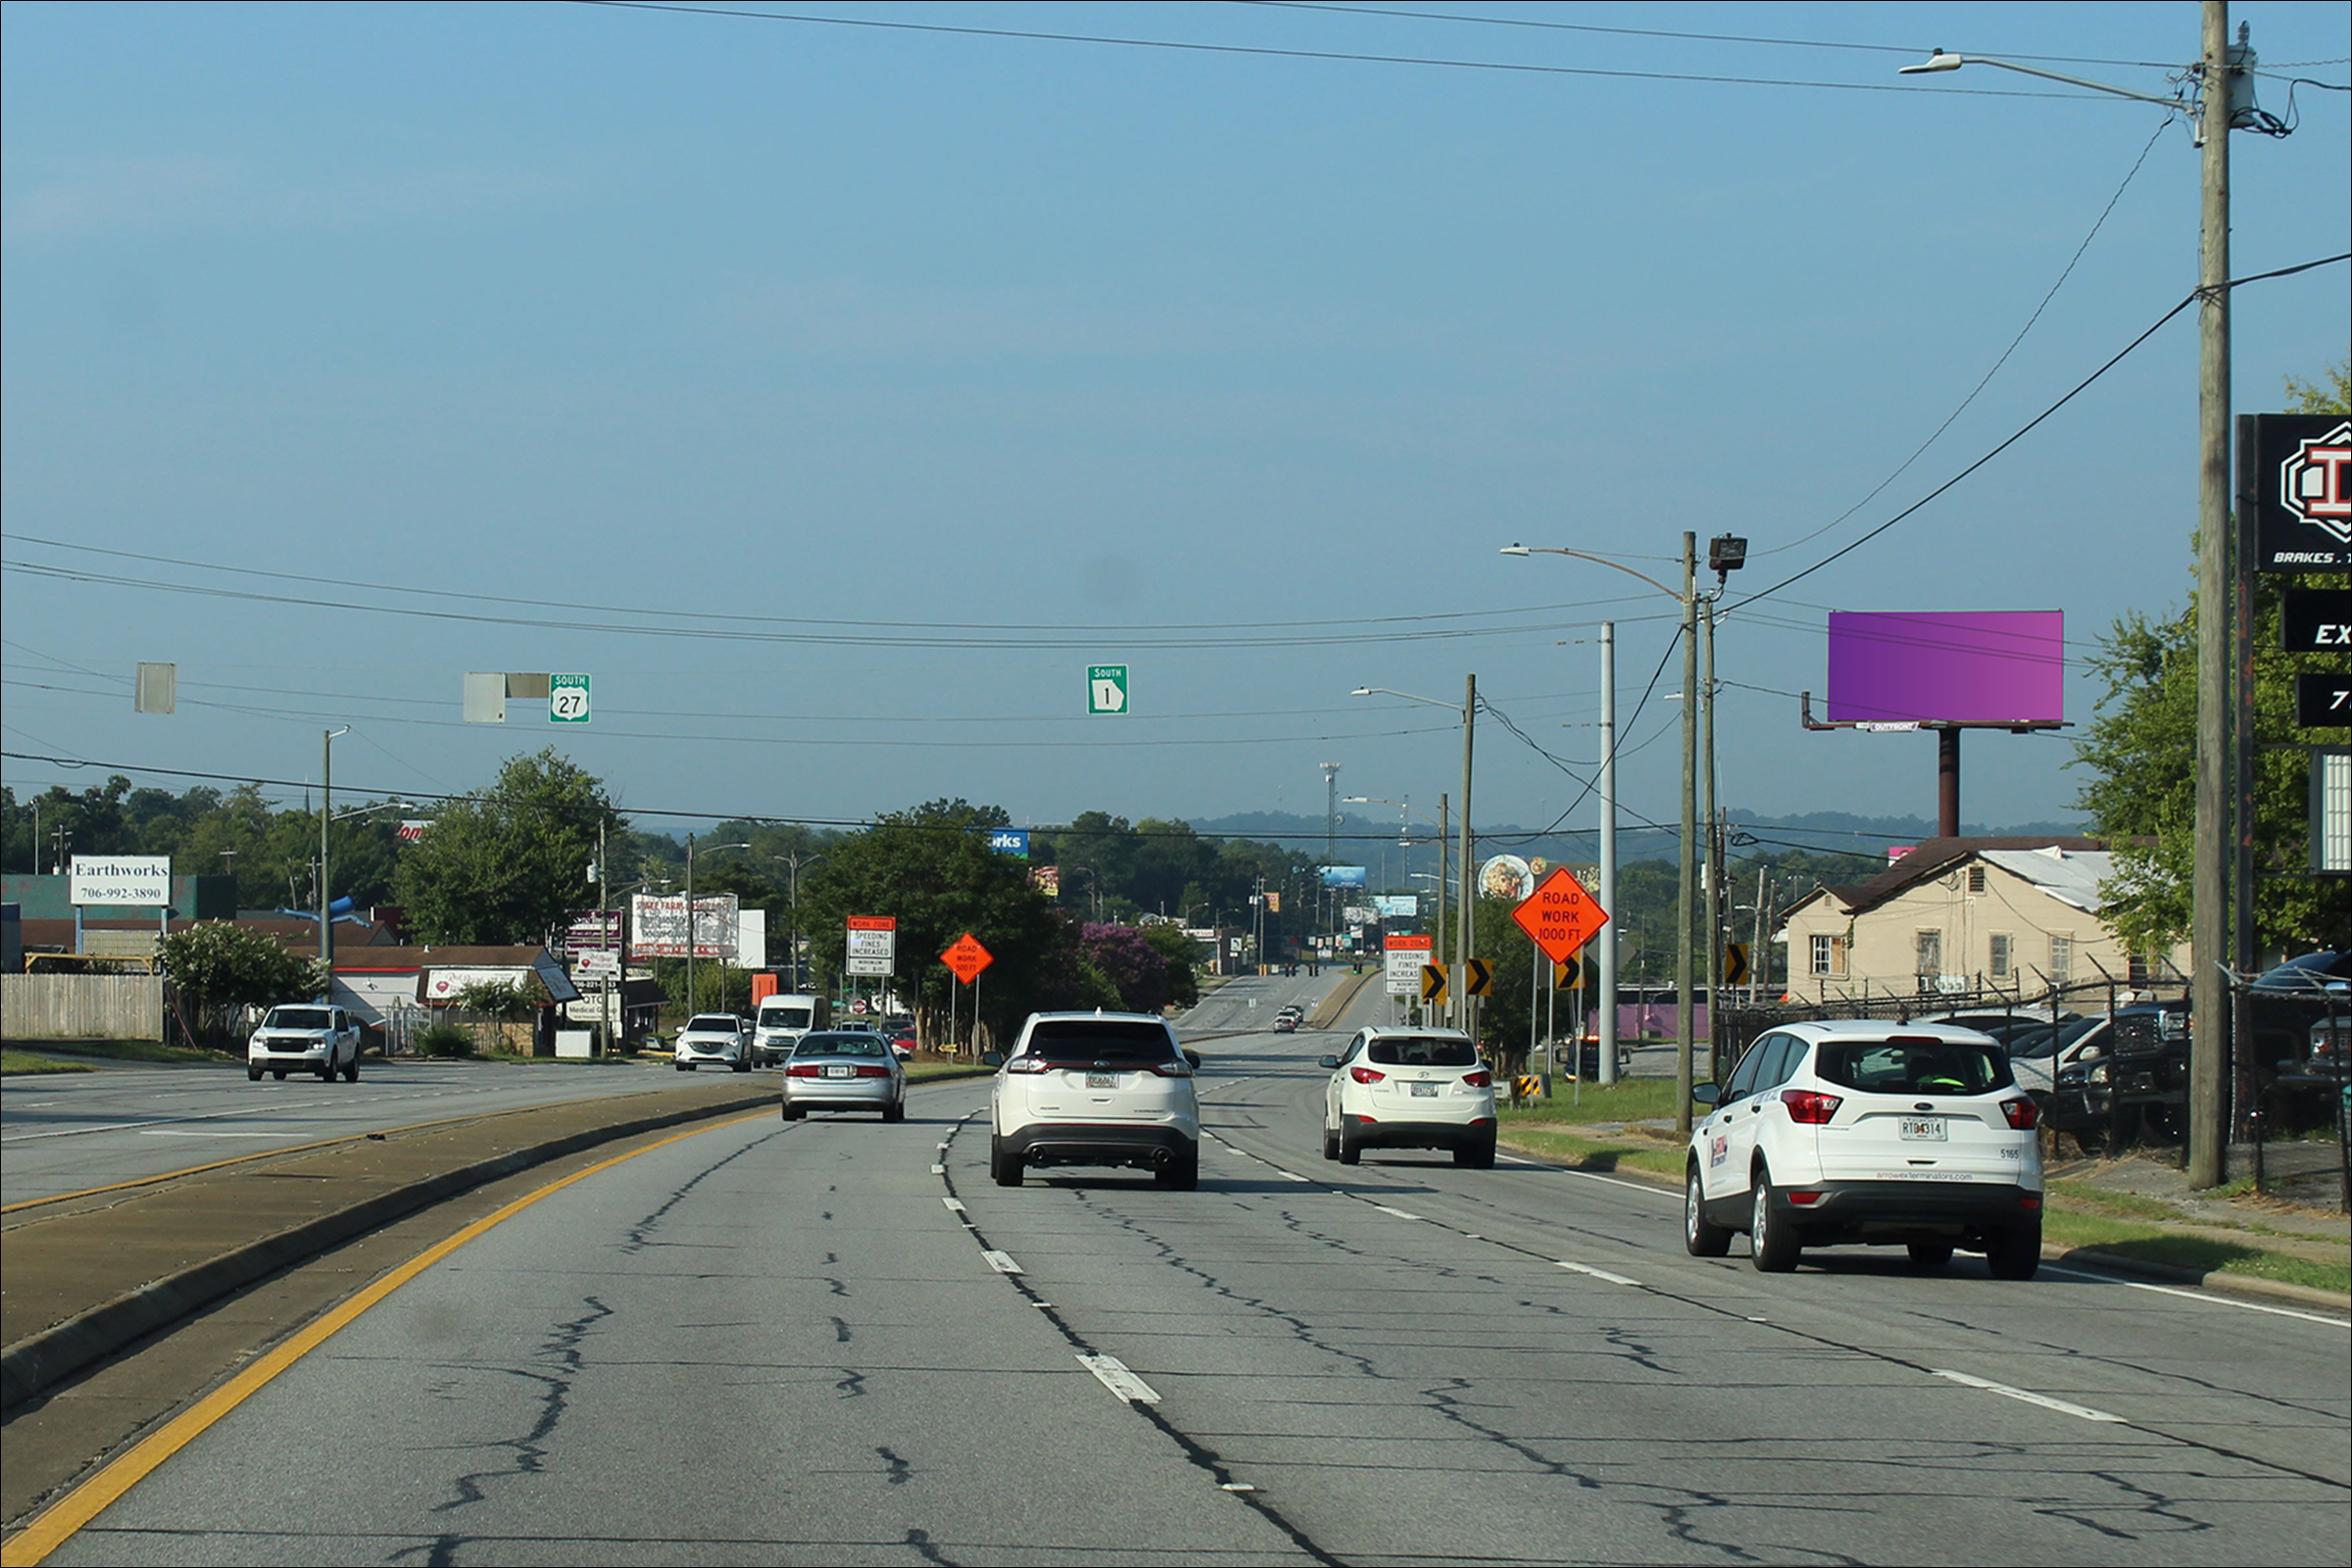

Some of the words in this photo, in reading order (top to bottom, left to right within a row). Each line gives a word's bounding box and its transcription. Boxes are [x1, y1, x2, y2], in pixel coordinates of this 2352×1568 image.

[2274, 553, 2334, 564] BRAKES
[1094, 667, 1122, 678] SOUTH
[555, 675, 586, 685] SOUTH
[1104, 687, 1109, 705] 1
[2329, 691, 2351, 710] 7
[559, 696, 581, 713] 27
[75, 863, 169, 876] Earthworks
[80, 888, 161, 899] 706-992-3890
[1543, 892, 1580, 905] ROAD
[1542, 910, 1580, 923] WORK
[856, 932, 888, 941] SPEEDING
[1539, 928, 1566, 941] 1000
[1568, 929, 1581, 941] FT
[1392, 952, 1424, 960] SPEEDING
[568, 1005, 595, 1014] Medical
[1876, 1171, 1974, 1182] arrowexterminators.com
